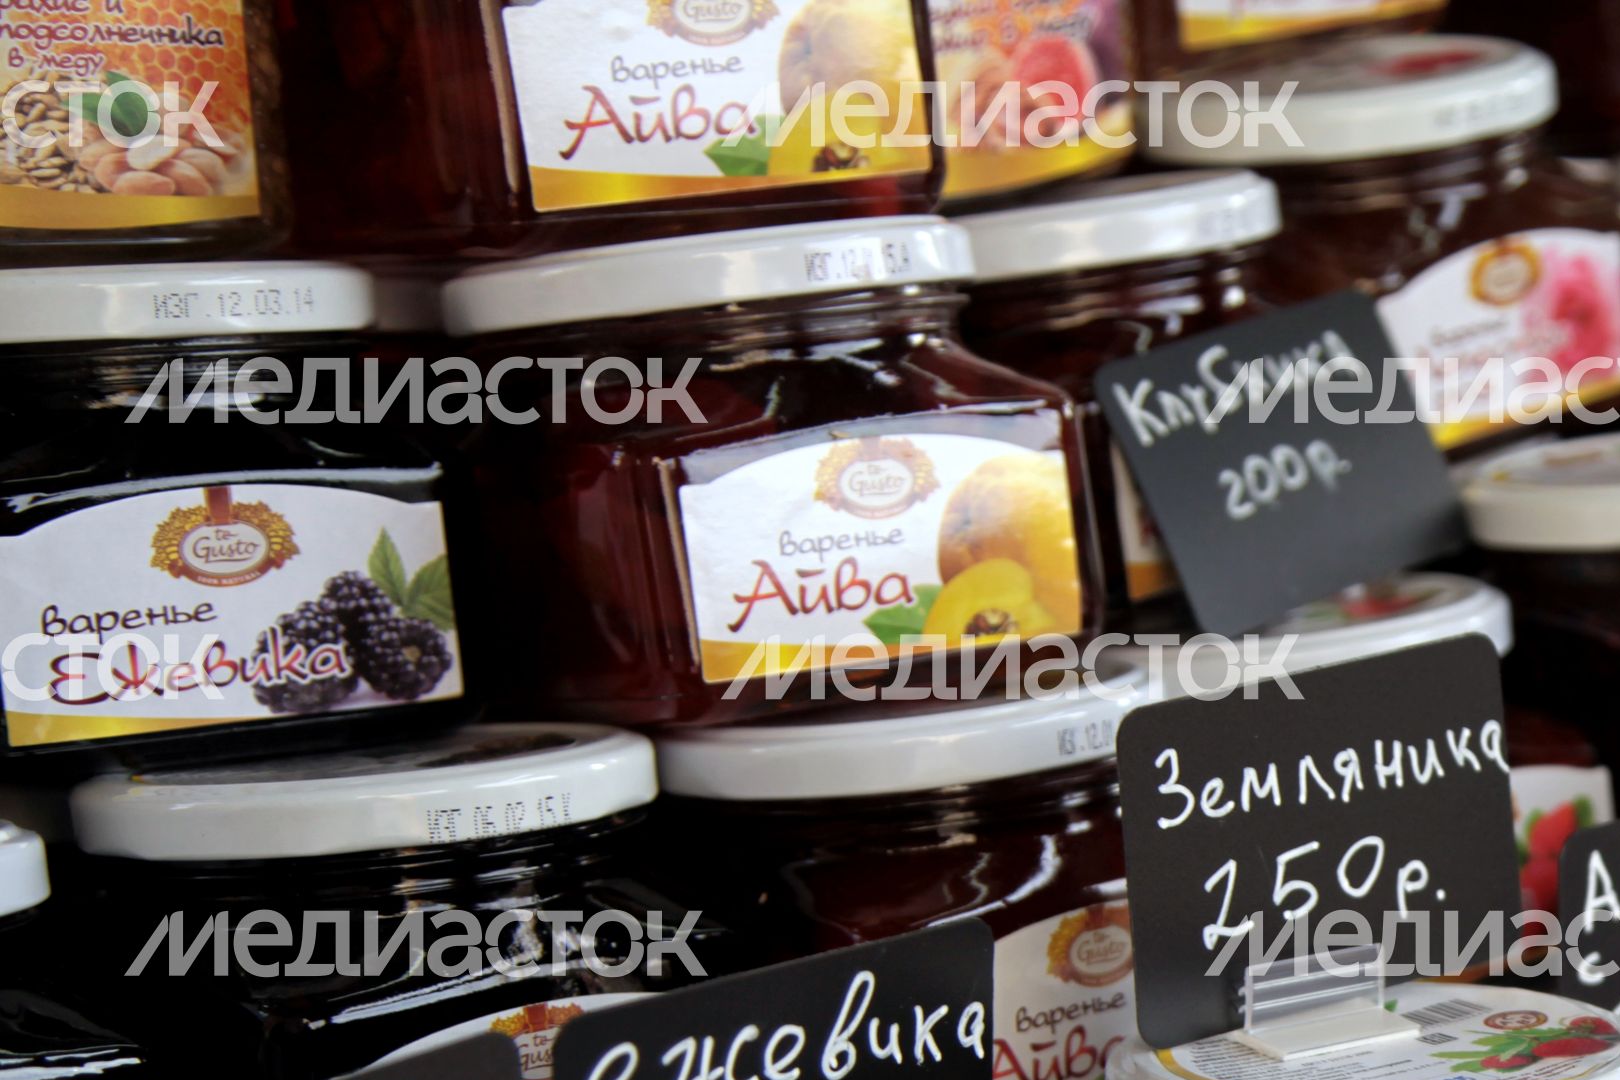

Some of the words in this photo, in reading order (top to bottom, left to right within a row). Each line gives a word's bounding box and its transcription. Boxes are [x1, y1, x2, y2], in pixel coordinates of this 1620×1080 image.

[560, 83, 758, 160] Айва
[193, 537, 260, 563] Gusto
[727, 556, 916, 633] Айва
[49, 626, 349, 705] Ежевика
[1155, 720, 1510, 829] Земляника
[1203, 836, 1446, 950] 250р.
